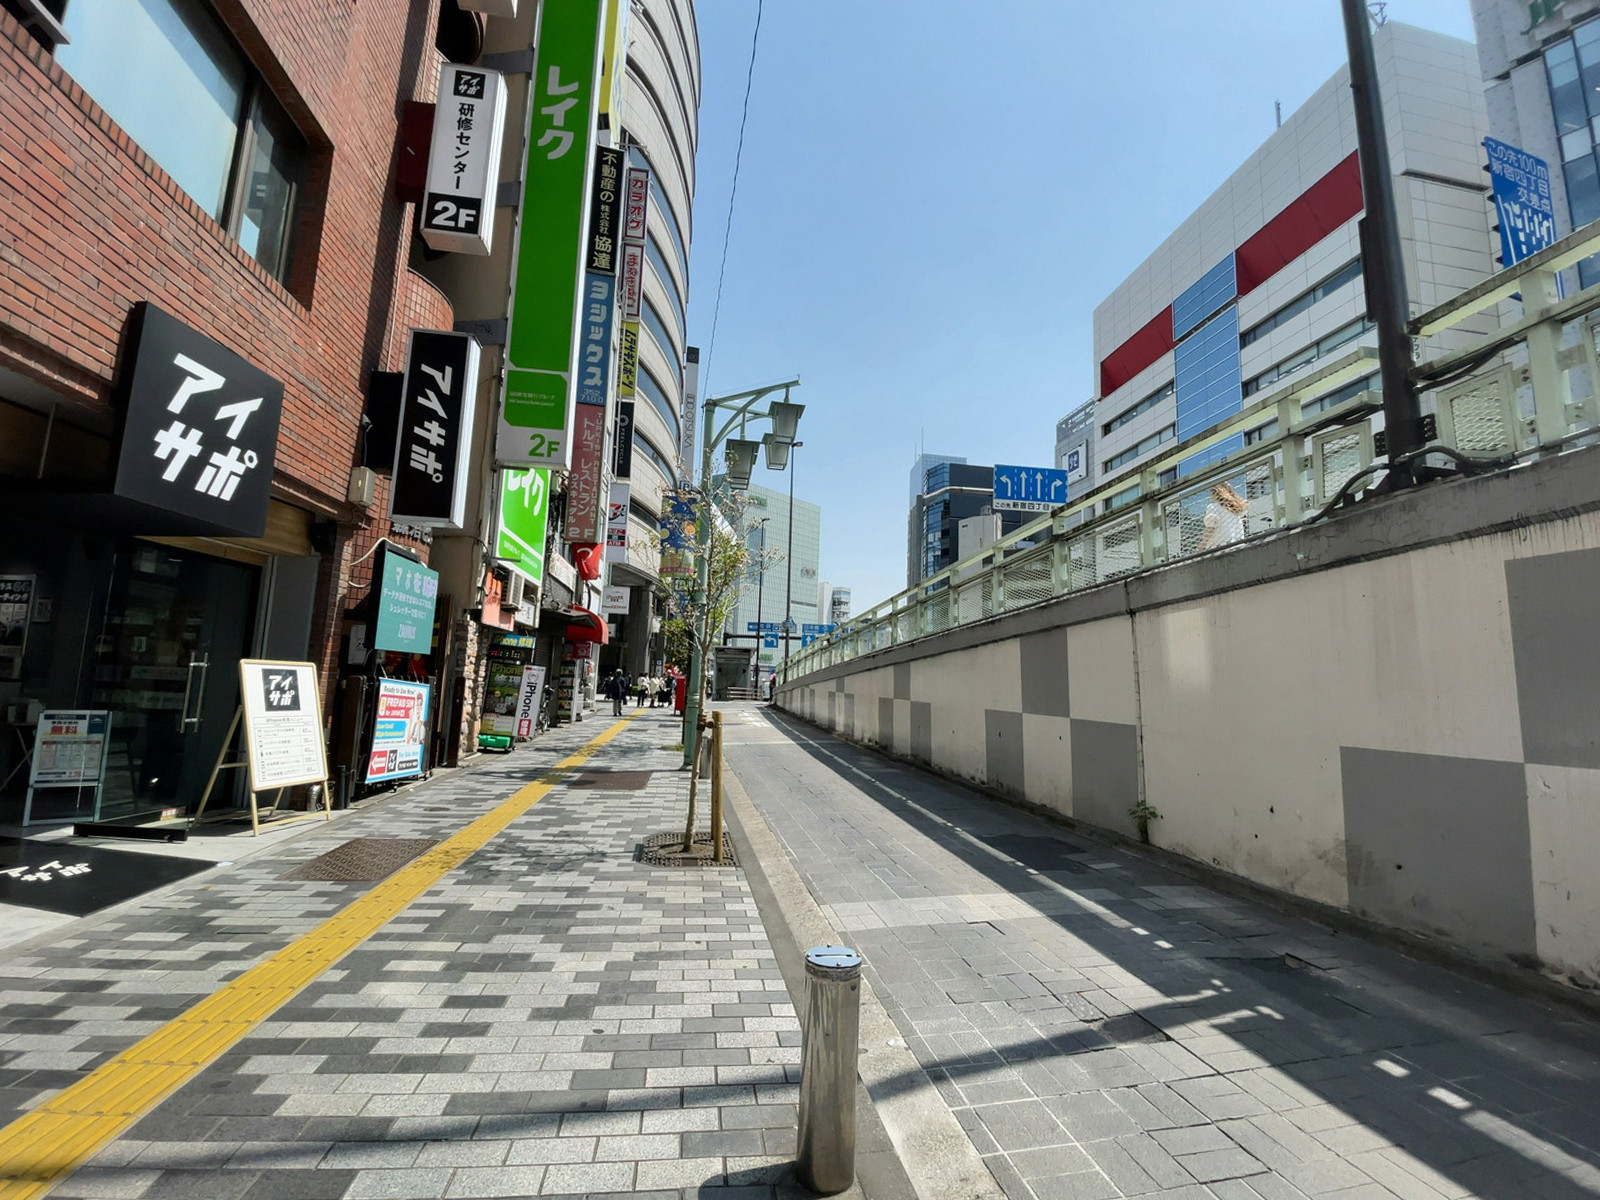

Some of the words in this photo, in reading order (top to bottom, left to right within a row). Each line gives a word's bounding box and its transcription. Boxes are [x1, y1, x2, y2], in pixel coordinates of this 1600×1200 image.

[537, 65, 579, 160] レイク
[453, 102, 475, 190] 研修センター
[1491, 158, 1549, 197] 新宿四丁目
[431, 200, 477, 229] 2F
[628, 178, 644, 231] カラオケ
[1517, 186, 1552, 215] 交差点
[583, 280, 609, 387] ヨシックス
[625, 328, 637, 390] ムラサキスポーツ
[166, 352, 264, 441] アイ
[580, 394, 604, 404] 7100
[583, 388, 601, 397] 352
[409, 363, 453, 484] アイサポ
[581, 417, 595, 452] トルコ
[594, 412, 603, 458] TURKISH
[684, 411, 695, 449] OTSUKA
[153, 420, 258, 502] サポ
[528, 433, 560, 458] 2F
[577, 458, 593, 516] レストラン
[589, 460, 600, 525] RESTAURANT
[1012, 502, 1050, 511] 新宿四丁目
[268, 675, 293, 691] アイ
[268, 690, 295, 706] サポ
[521, 681, 538, 719] iPhone
